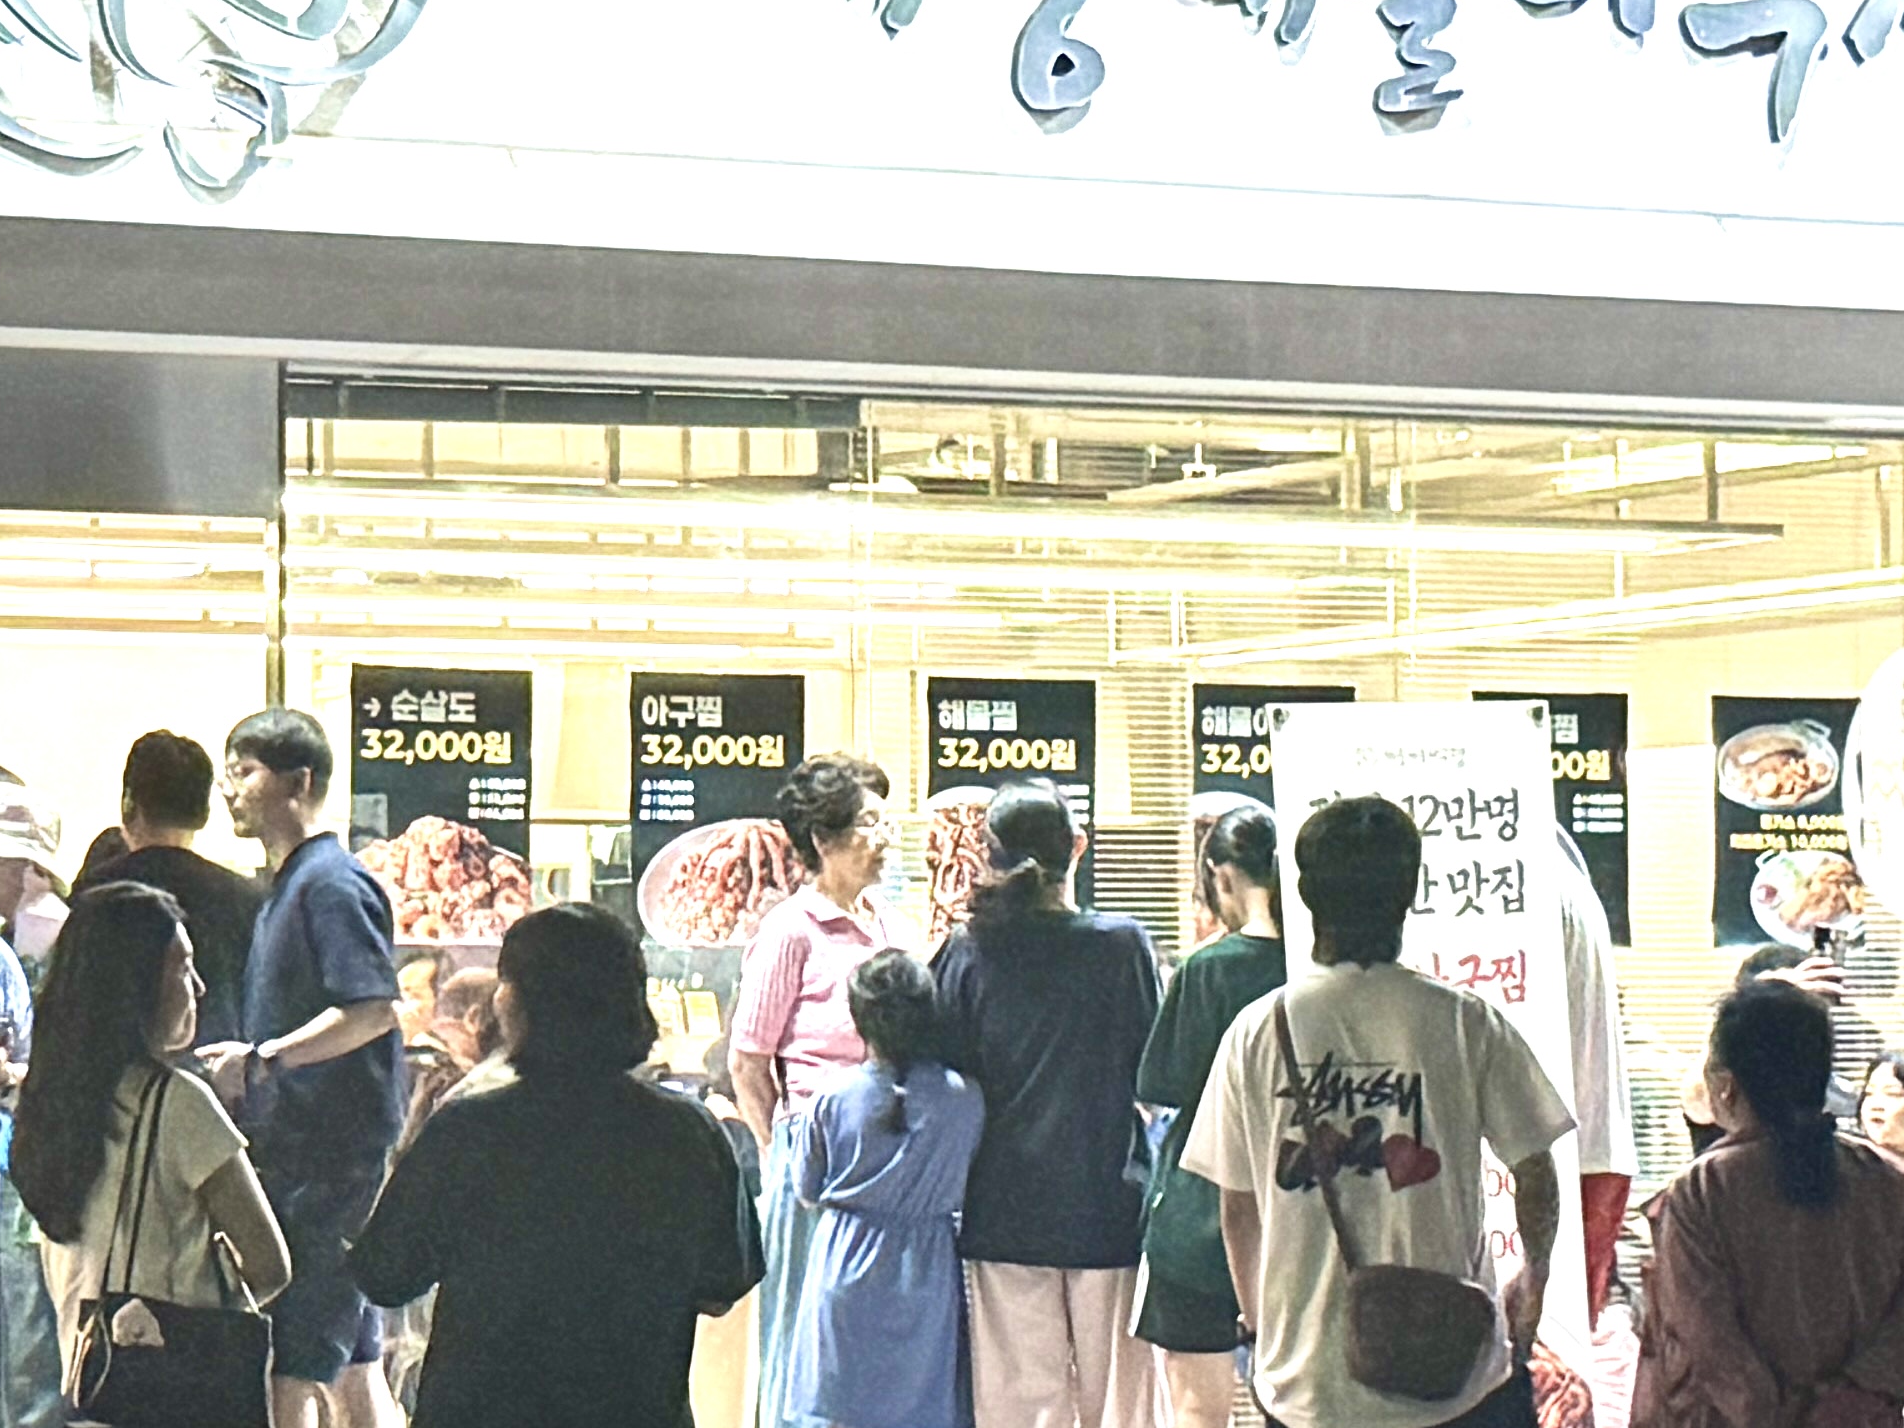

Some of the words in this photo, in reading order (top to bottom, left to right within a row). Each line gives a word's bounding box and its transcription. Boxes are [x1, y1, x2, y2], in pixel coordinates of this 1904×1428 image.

[641, 694, 723, 728] 아구찜
[938, 699, 1017, 730] 해물찜
[360, 728, 512, 765] 32,000원
[641, 733, 784, 770] 32,000원
[937, 738, 1077, 774] 32,000원
[1447, 859, 1525, 916] 맛집
